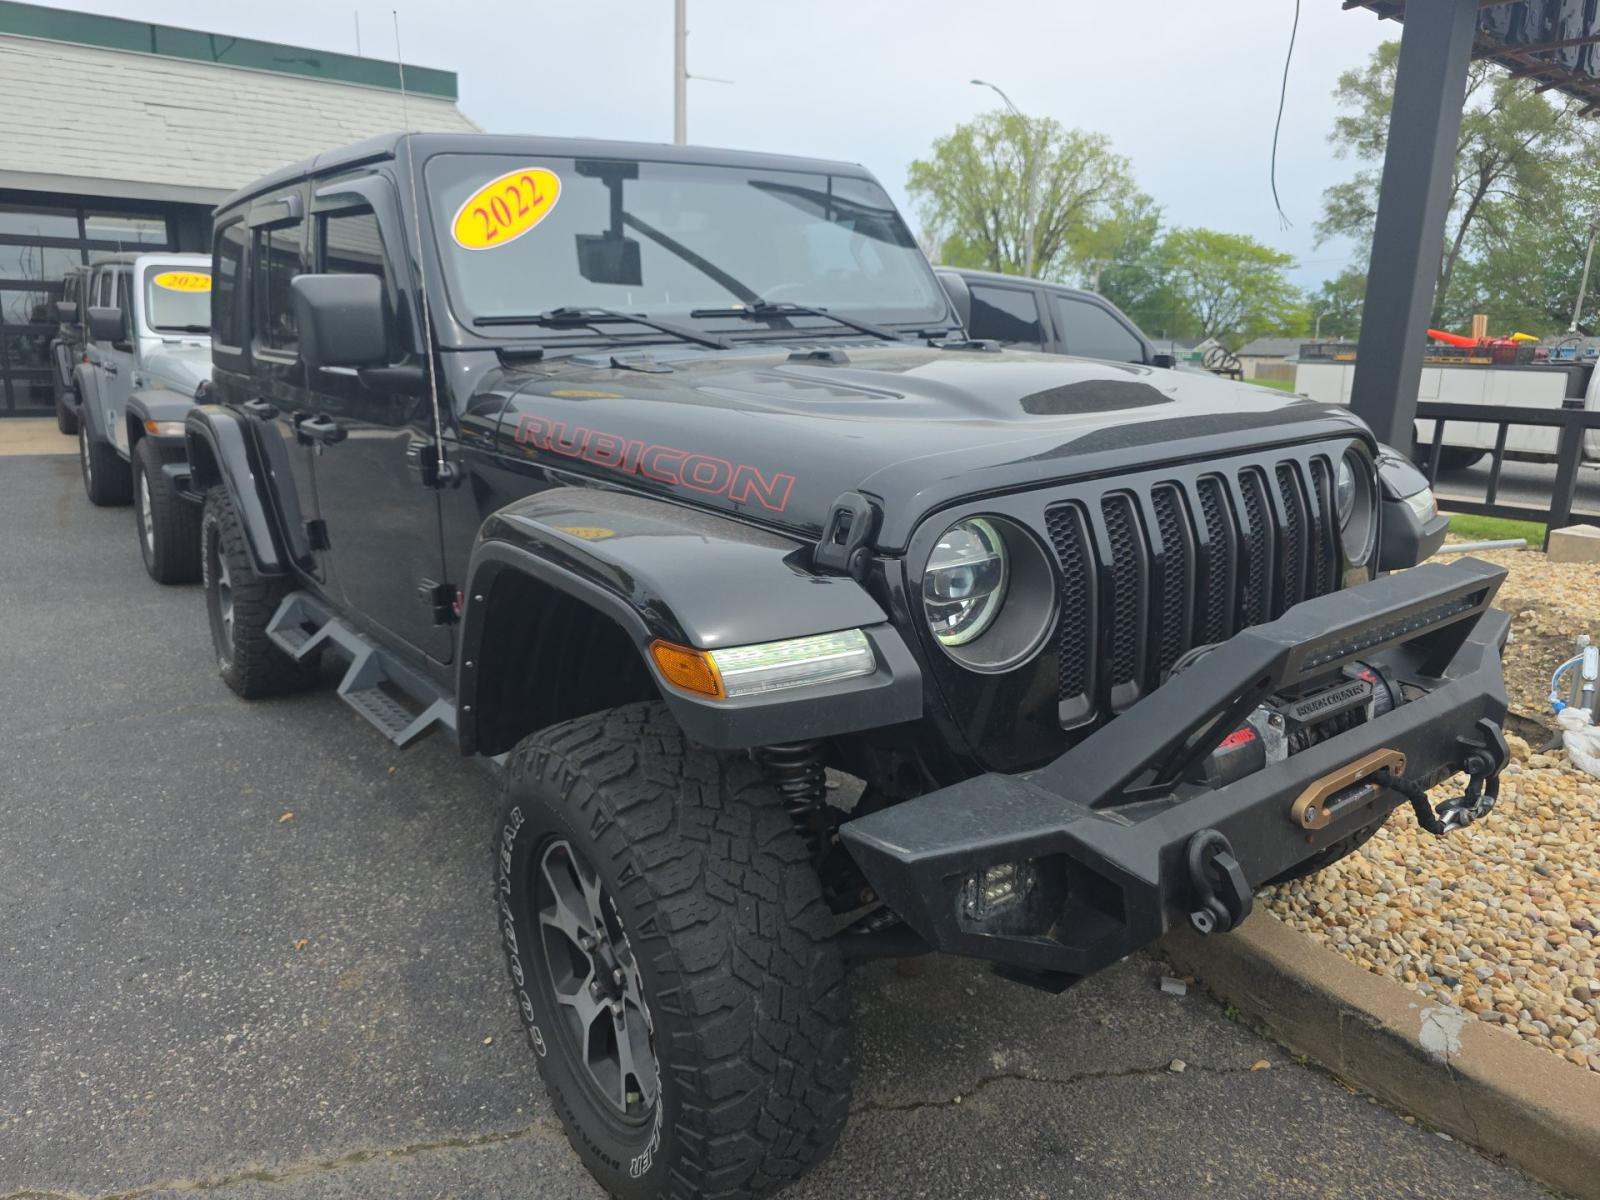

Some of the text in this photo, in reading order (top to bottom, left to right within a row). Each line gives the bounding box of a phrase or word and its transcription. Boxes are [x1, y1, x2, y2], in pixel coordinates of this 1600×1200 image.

[473, 175, 544, 241] 2022
[167, 274, 210, 288] 2022
[514, 414, 796, 512] RUBICON
[499, 806, 547, 1058] GOODYEAR
